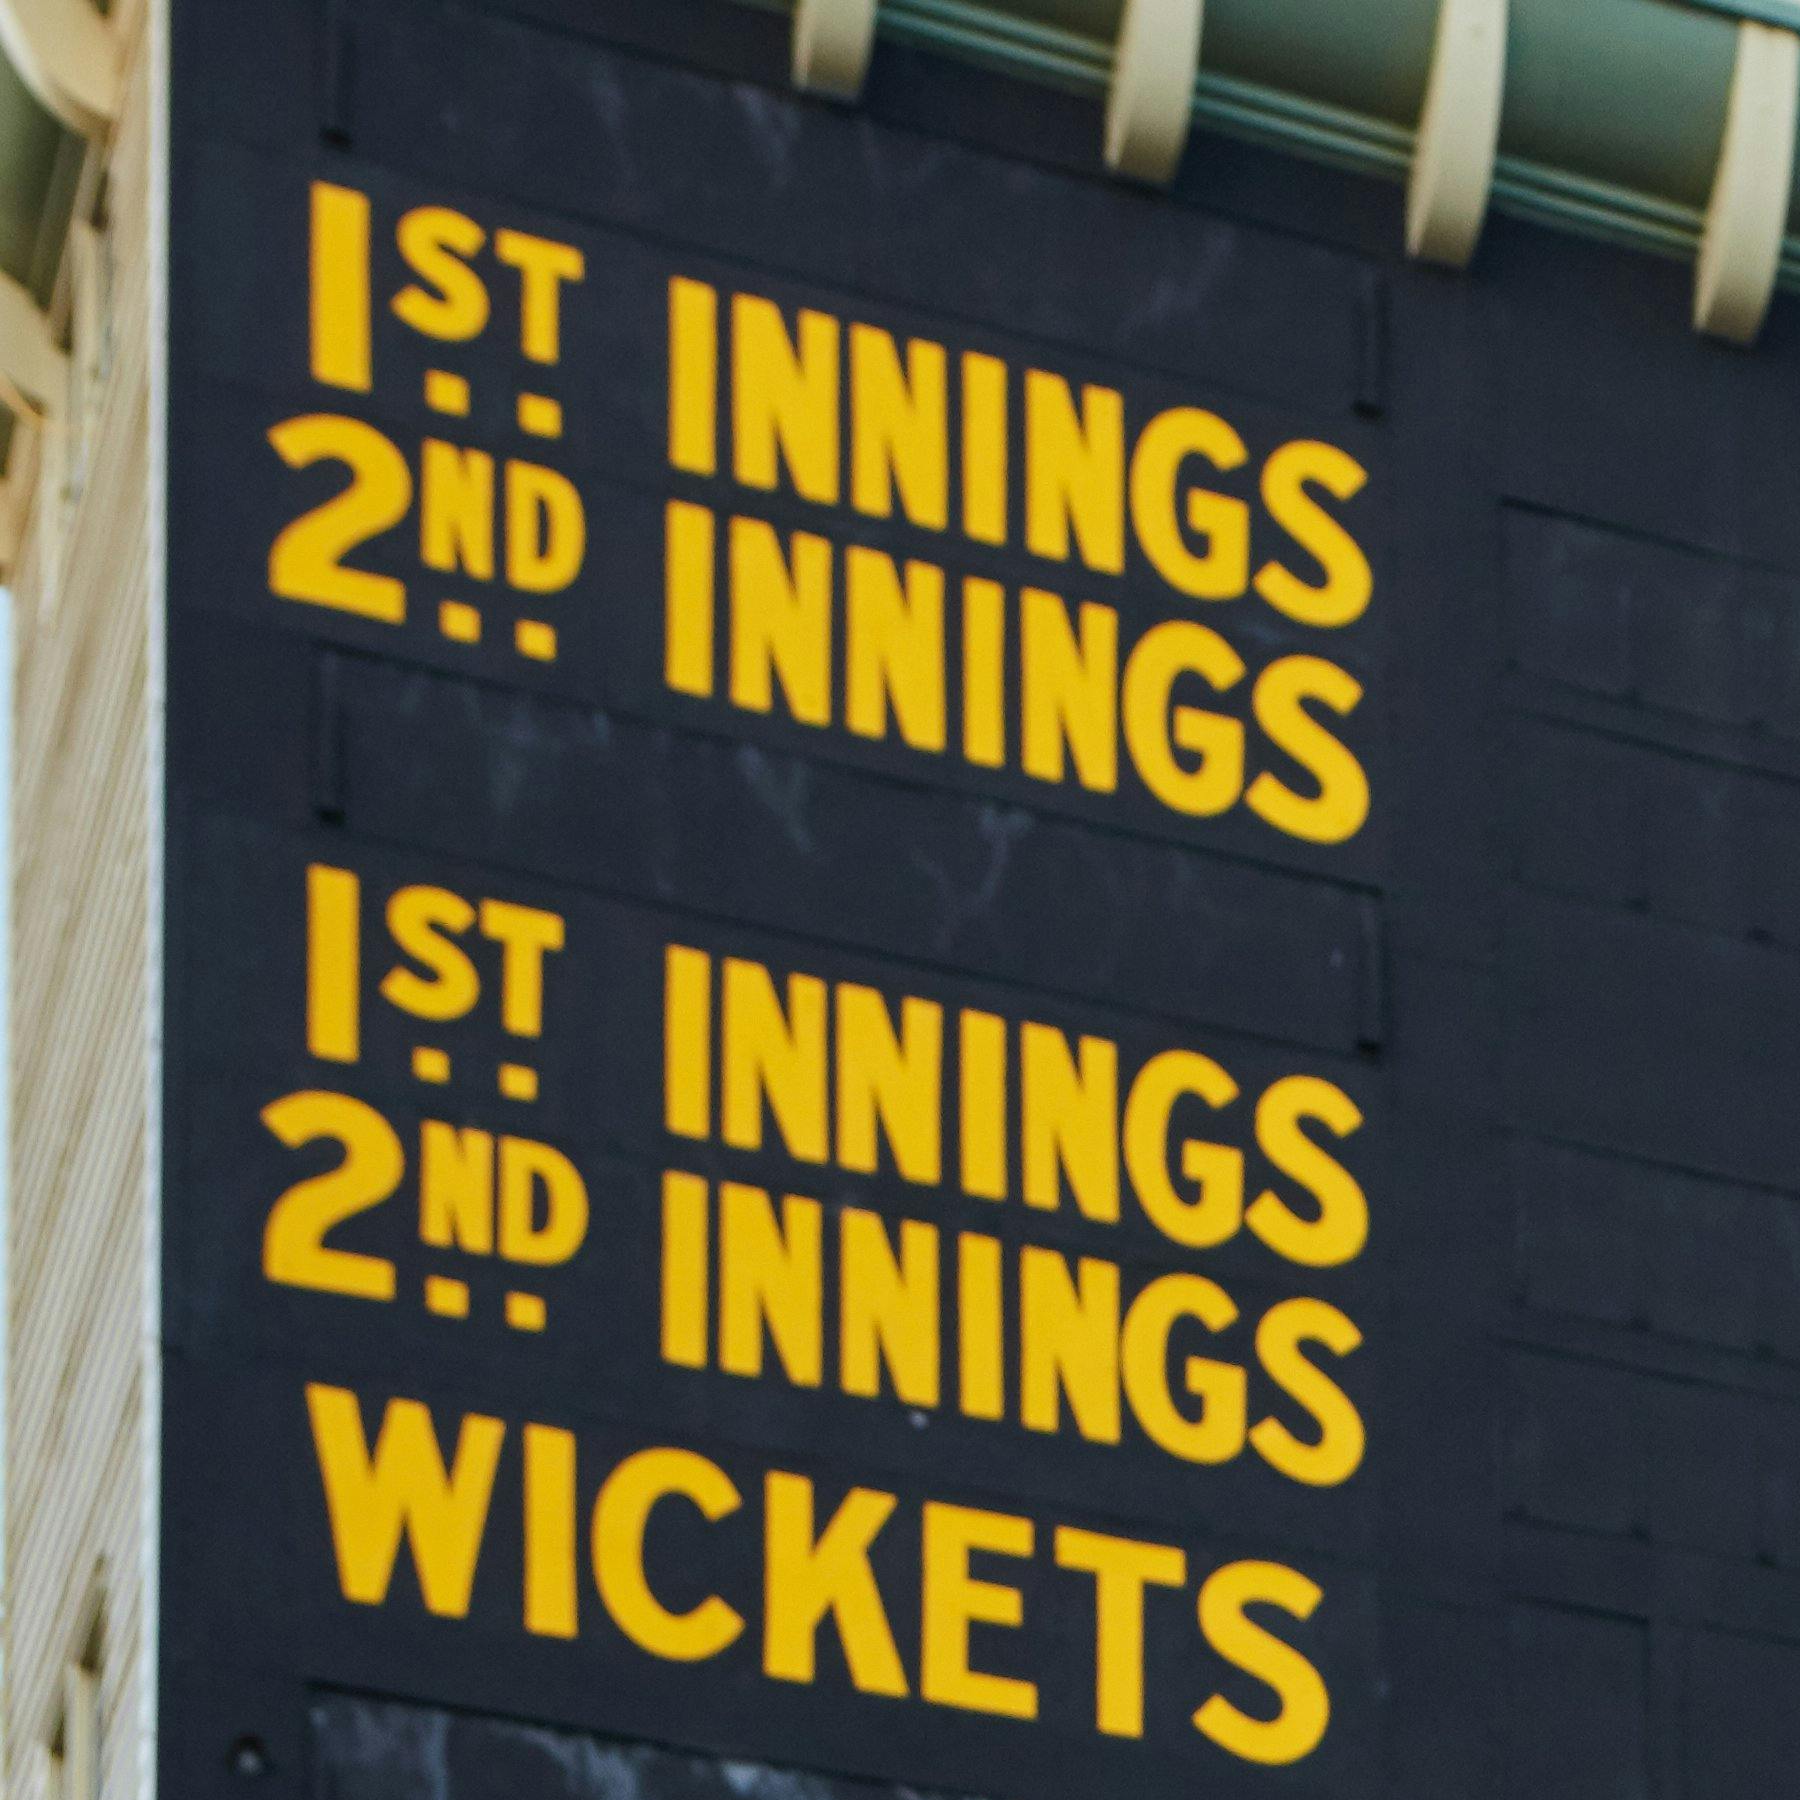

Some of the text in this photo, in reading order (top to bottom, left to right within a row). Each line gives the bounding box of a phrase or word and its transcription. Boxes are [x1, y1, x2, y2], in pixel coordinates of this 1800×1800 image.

[309, 181, 1374, 629] 1ST INNINGS
[267, 413, 1370, 844] 2ND INNINGS
[306, 863, 1370, 1268] 1ST INNINGS
[261, 1089, 1366, 1487] 2ND INNINGS
[304, 1382, 1331, 1766] WICKETS
